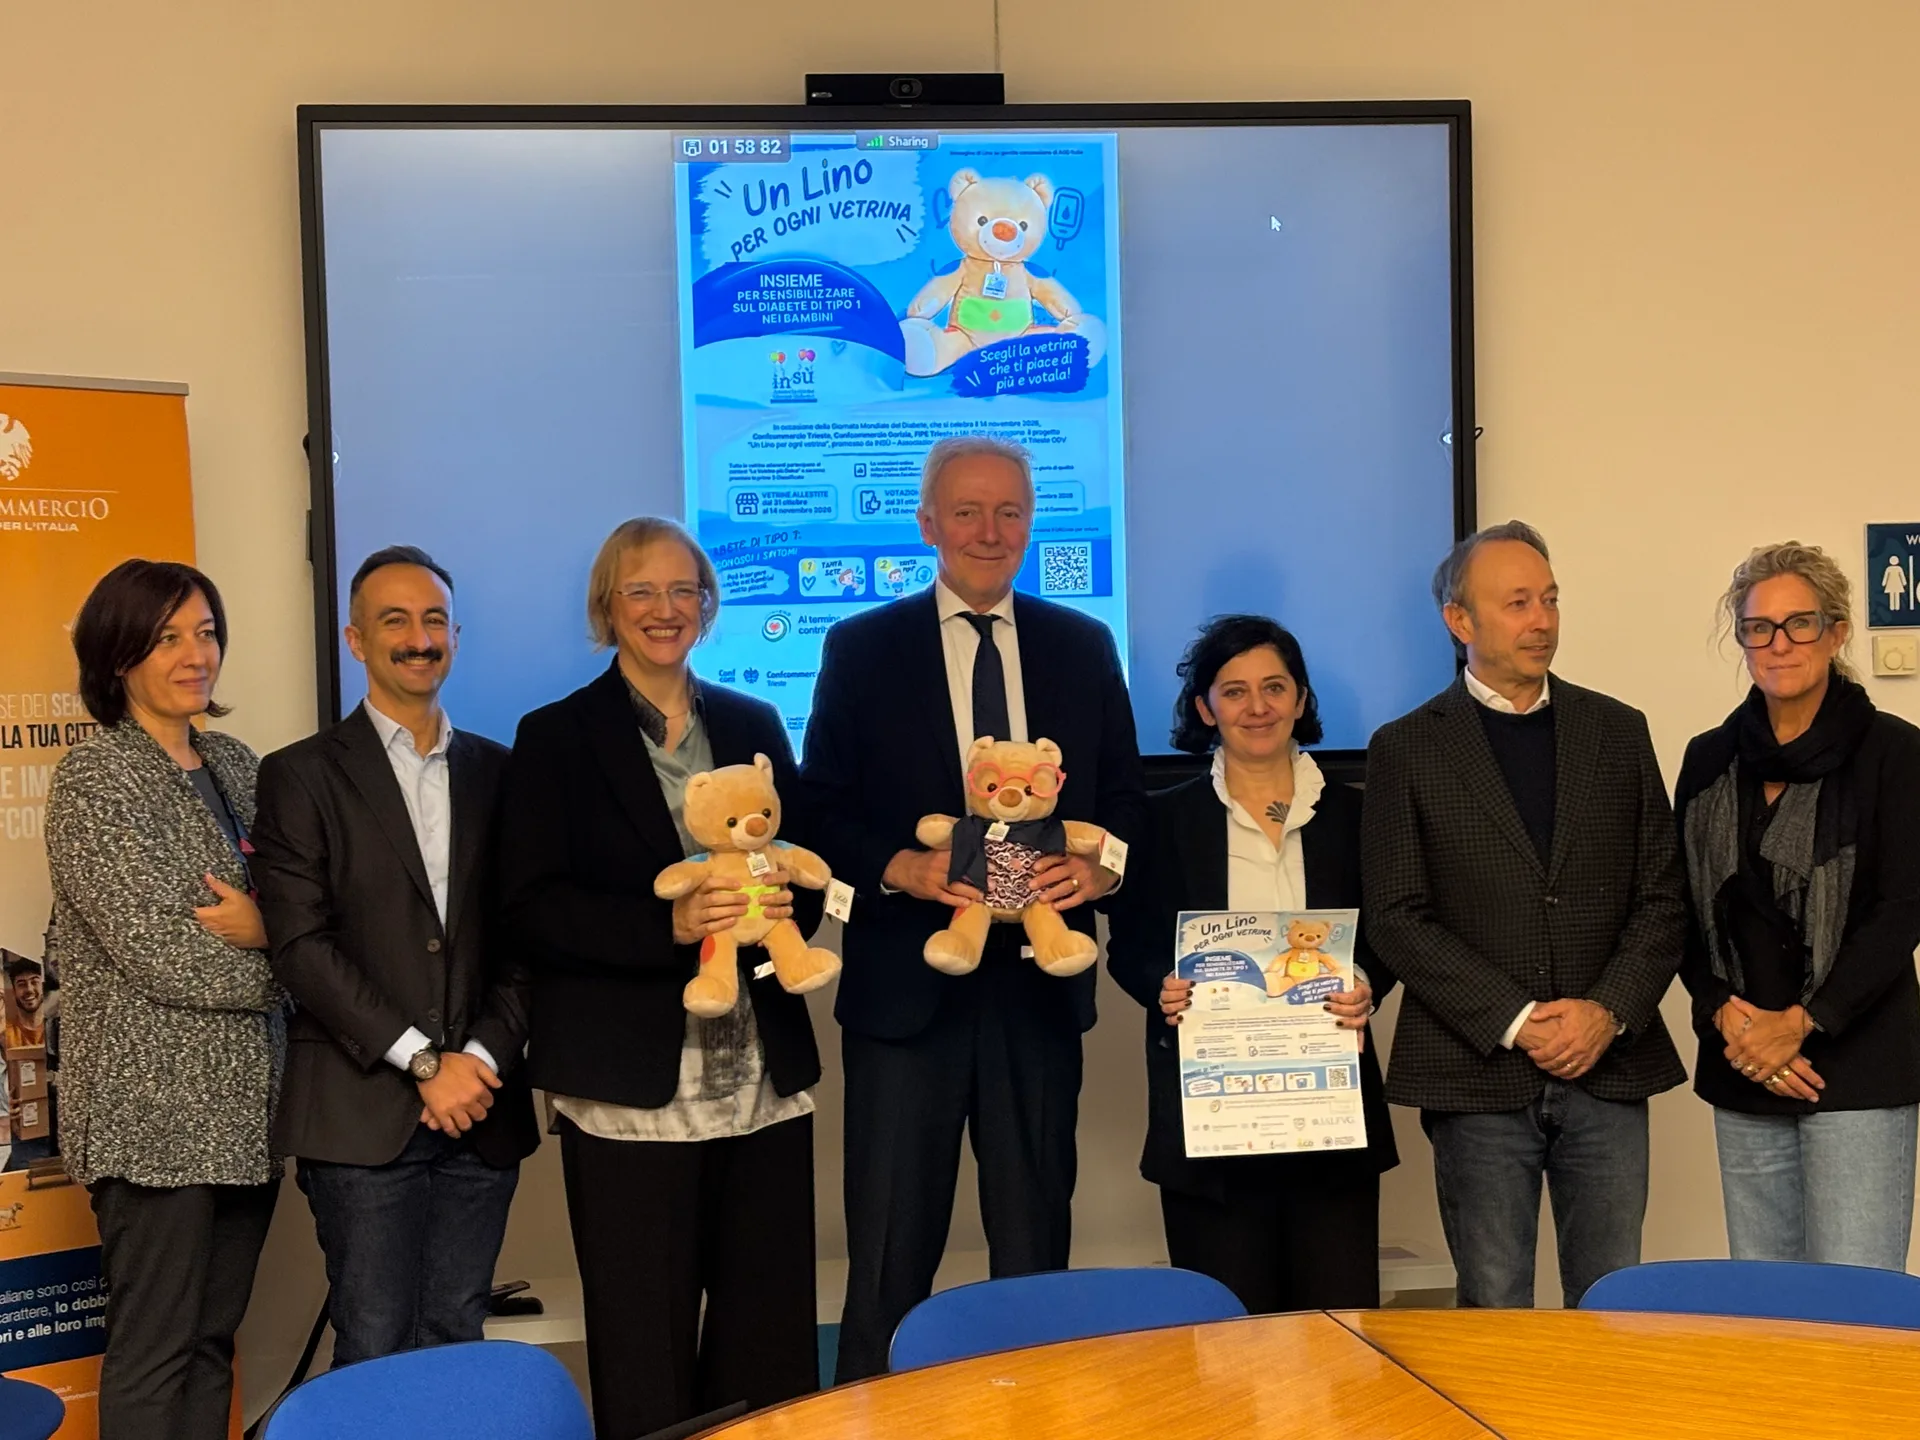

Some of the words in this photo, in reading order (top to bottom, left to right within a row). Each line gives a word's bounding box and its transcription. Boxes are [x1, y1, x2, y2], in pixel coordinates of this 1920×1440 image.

[708, 140, 728, 155] 01
[734, 140, 756, 154] 58
[760, 140, 782, 154] 82
[888, 136, 929, 149] Sharing
[743, 179, 790, 217] Un
[801, 158, 873, 202] Lino
[730, 227, 768, 262] PER
[773, 206, 821, 237] OGNI
[828, 199, 912, 222] VETRINA
[759, 273, 824, 288] INSIEME
[737, 290, 760, 301] PER
[762, 288, 855, 300] SENSIBILIZZARE
[732, 302, 757, 313] SUL
[758, 301, 808, 312] DIABETE
[810, 300, 822, 311] DI
[825, 300, 853, 311] TIPO
[856, 299, 861, 310] 1
[762, 313, 782, 324] NEI
[783, 312, 834, 324] BAMBINI
[980, 344, 1016, 363] Scegli
[1018, 344, 1031, 357] la
[1034, 338, 1078, 354] vetrina
[989, 363, 1010, 376] che
[1013, 359, 1023, 372] ti
[1026, 356, 1059, 375] piace
[1060, 352, 1073, 365] di
[996, 376, 1015, 394] più
[1018, 376, 1025, 386] e
[1028, 367, 1071, 386] votala!
[914, 430, 929, 438] FIPE
[792, 490, 828, 498] ALLESTITE
[0, 498, 109, 520] MMERCIO
[24, 522, 80, 532] L'ITALIA
[713, 540, 746, 556] ABETE
[764, 532, 789, 545] TIPO
[880, 560, 888, 568] 2
[798, 616, 808, 624] Al
[718, 668, 736, 677] Conf
[766, 670, 816, 678] Confcommerc
[22, 694, 48, 719] DEI
[52, 693, 84, 717] SER
[2, 724, 23, 749] LA
[26, 724, 61, 748] TUA
[65, 722, 98, 747] CITT
[1200, 922, 1220, 936] Un
[1226, 916, 1258, 932] Lino
[1193, 940, 1210, 952] PER
[1212, 931, 1234, 944] OGNI
[0, 1288, 34, 1305] aliane
[36, 1283, 68, 1298] sono
[71, 1276, 97, 1292] così
[56, 1301, 68, 1314] lo
[72, 1294, 110, 1312] dobbi
[16, 1330, 24, 1340] e
[28, 1325, 52, 1338] alle
[55, 1318, 82, 1334] loro
